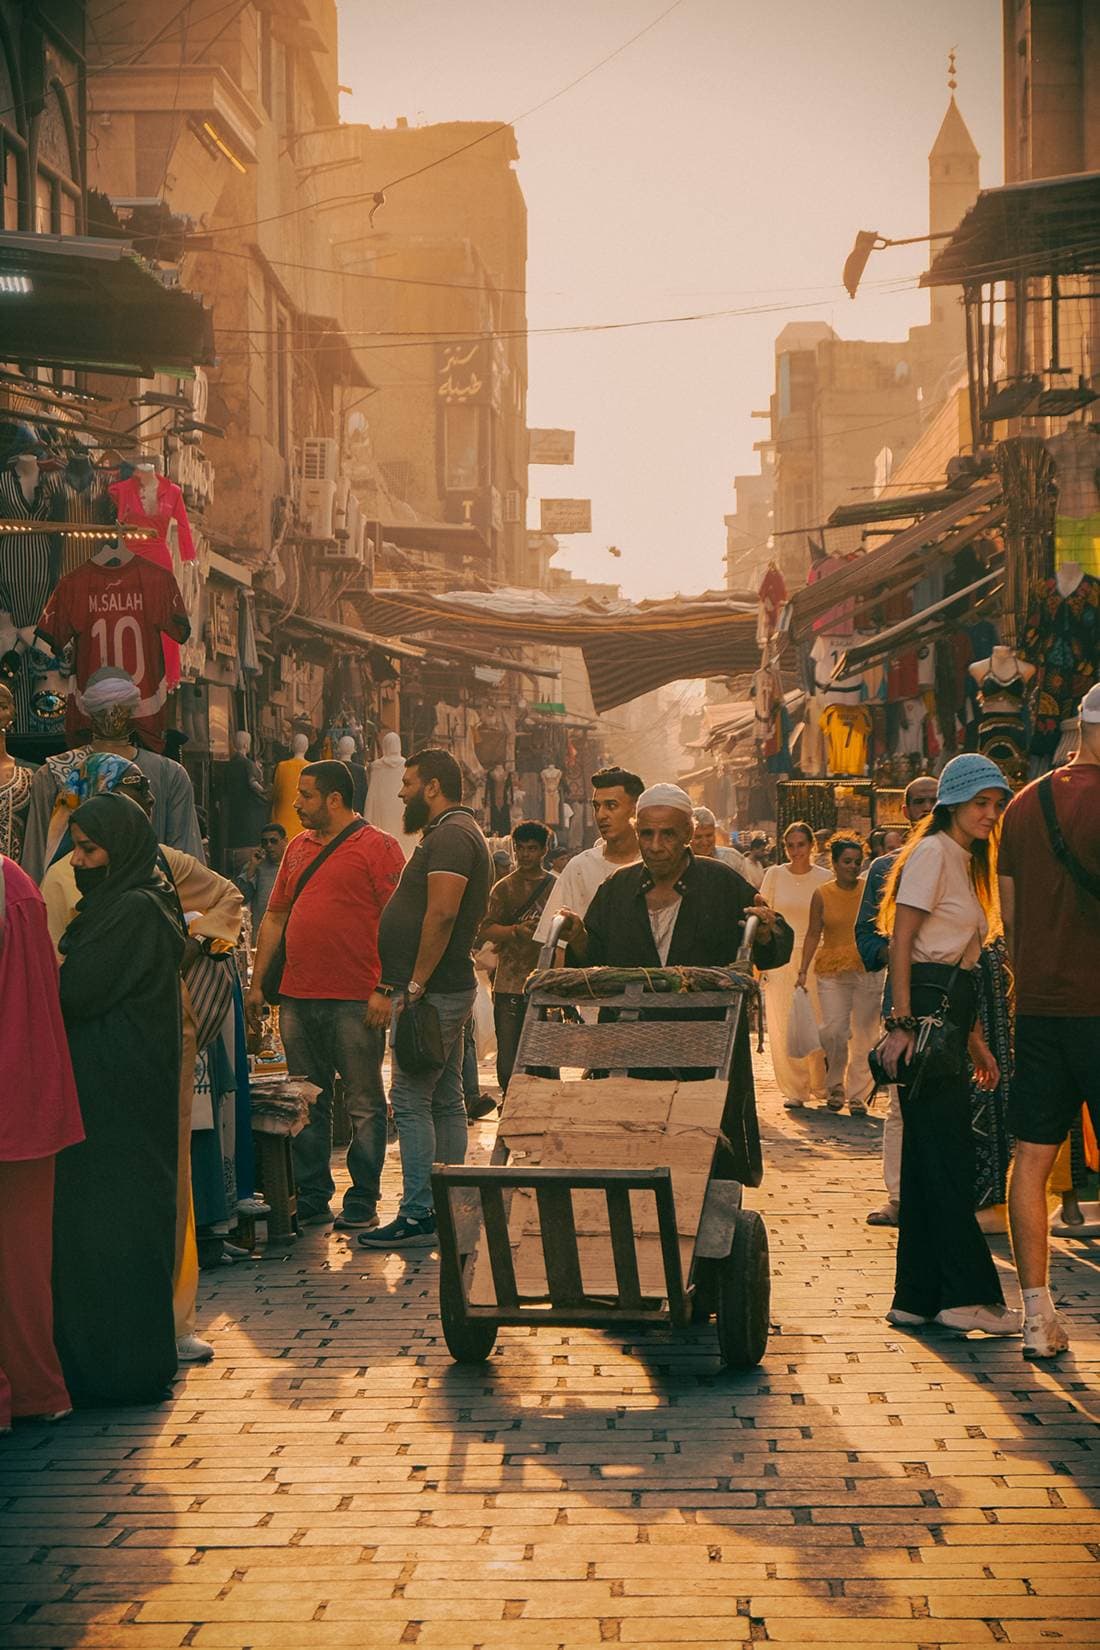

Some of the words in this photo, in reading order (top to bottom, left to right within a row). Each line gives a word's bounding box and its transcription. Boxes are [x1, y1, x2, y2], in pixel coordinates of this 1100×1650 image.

[88, 593, 143, 613] M.SALAH
[91, 616, 145, 686] 10
[843, 721, 854, 748] 7
